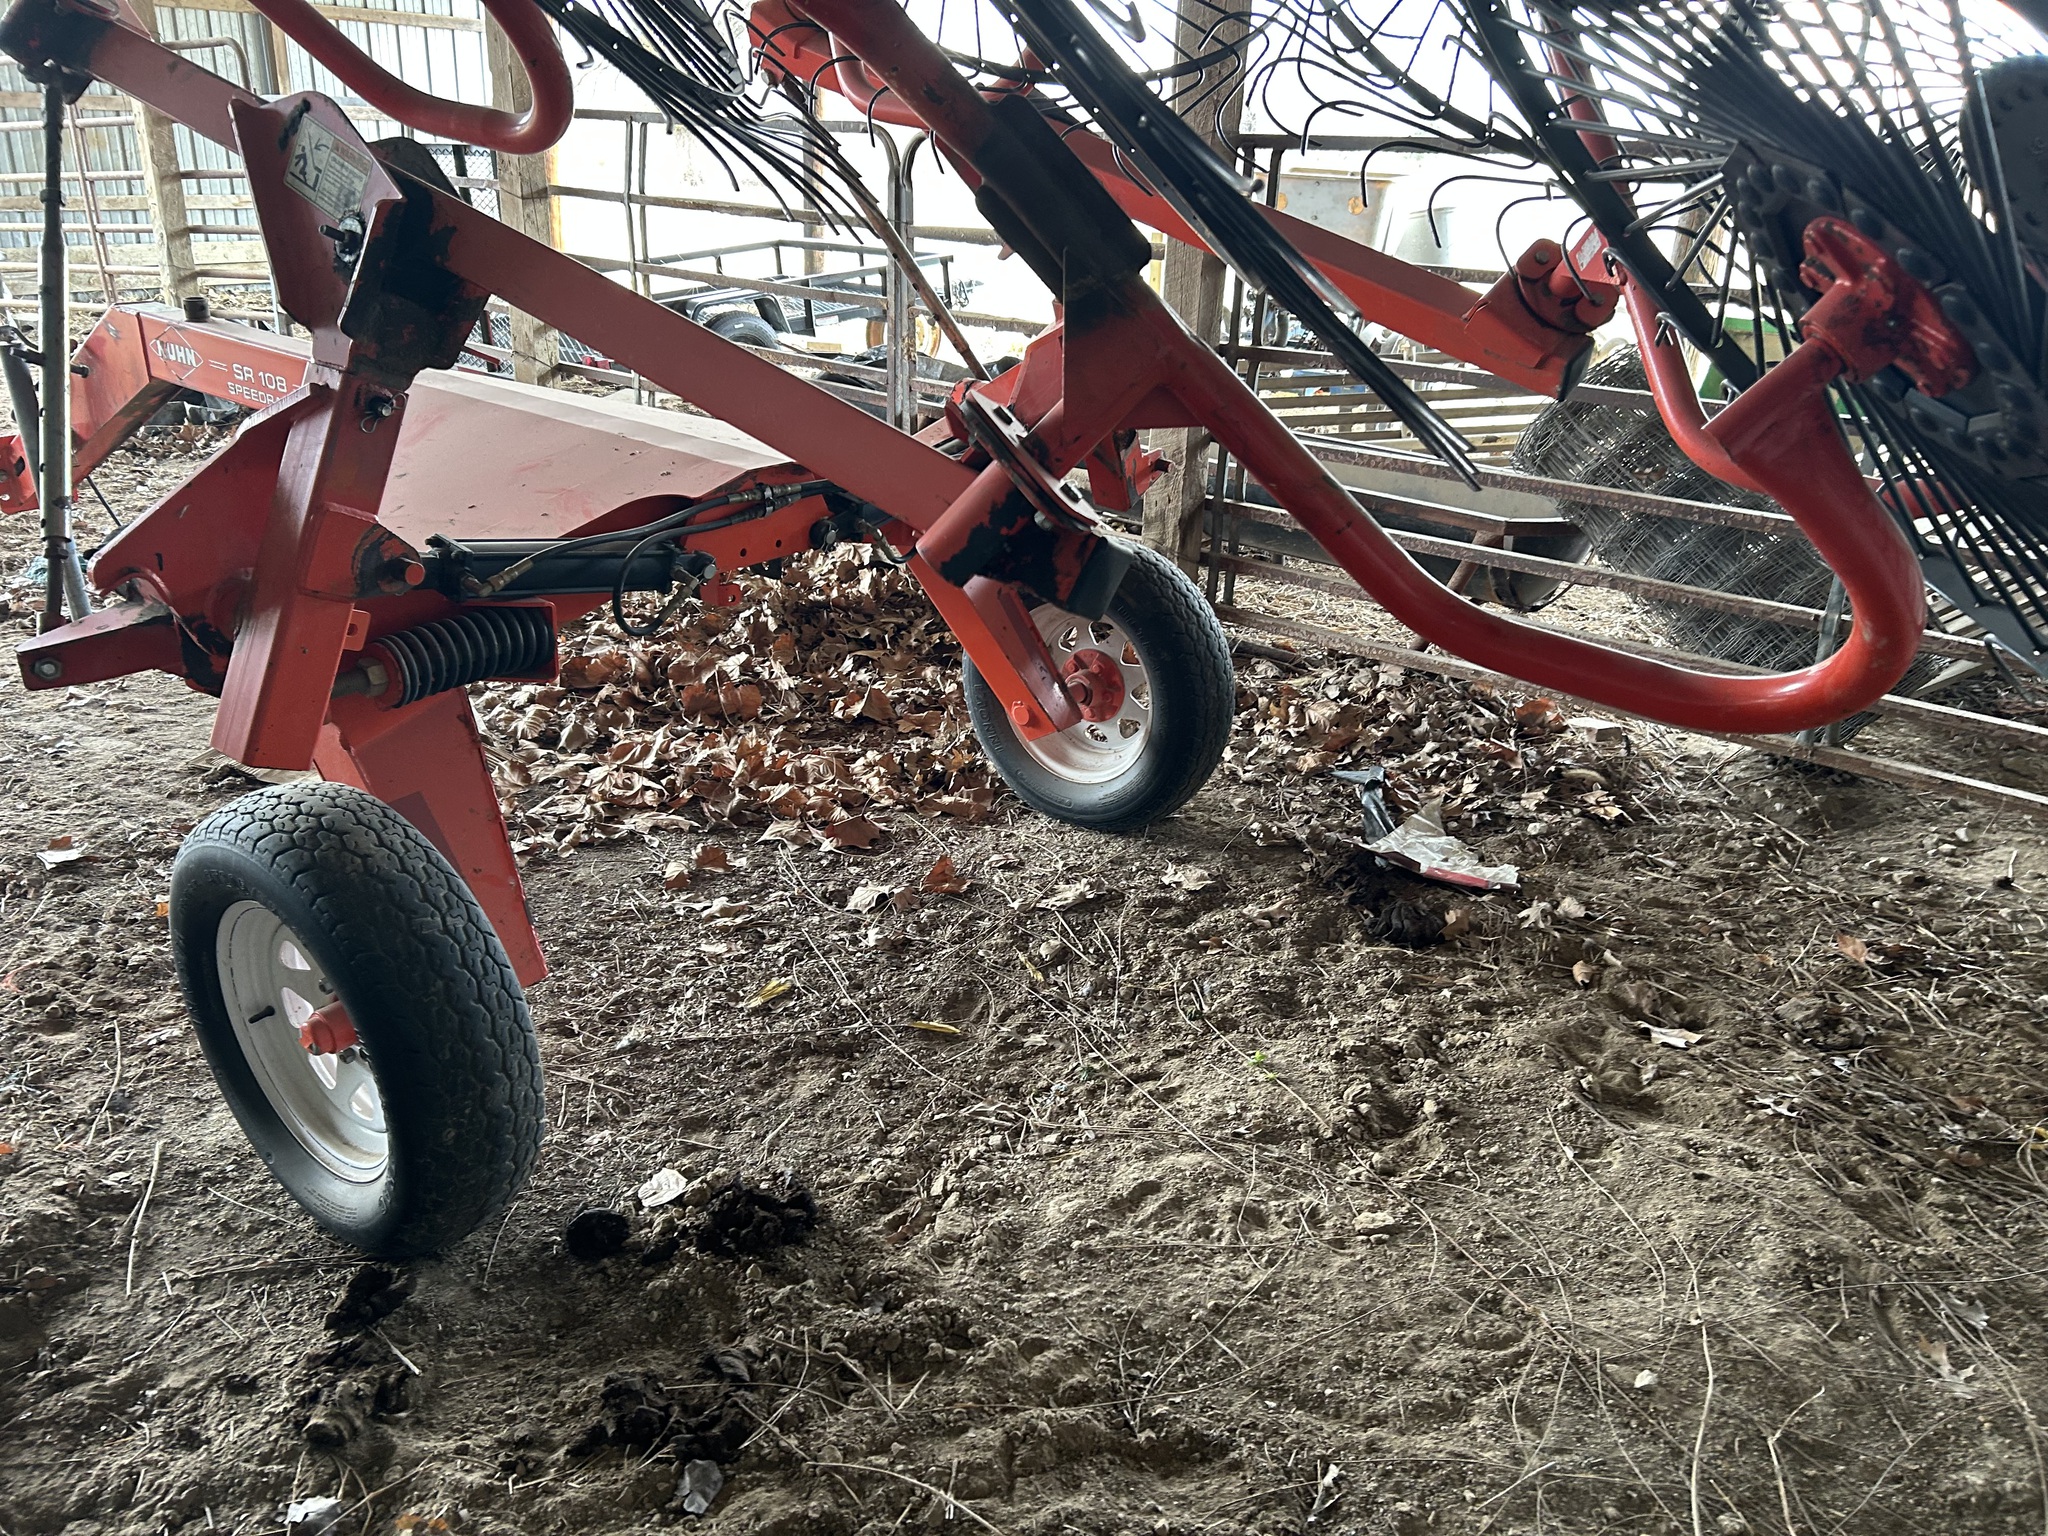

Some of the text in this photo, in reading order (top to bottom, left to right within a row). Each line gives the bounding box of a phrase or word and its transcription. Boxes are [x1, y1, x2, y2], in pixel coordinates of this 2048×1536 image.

[156, 339, 197, 368] KUHN
[231, 363, 288, 392] SR 108
